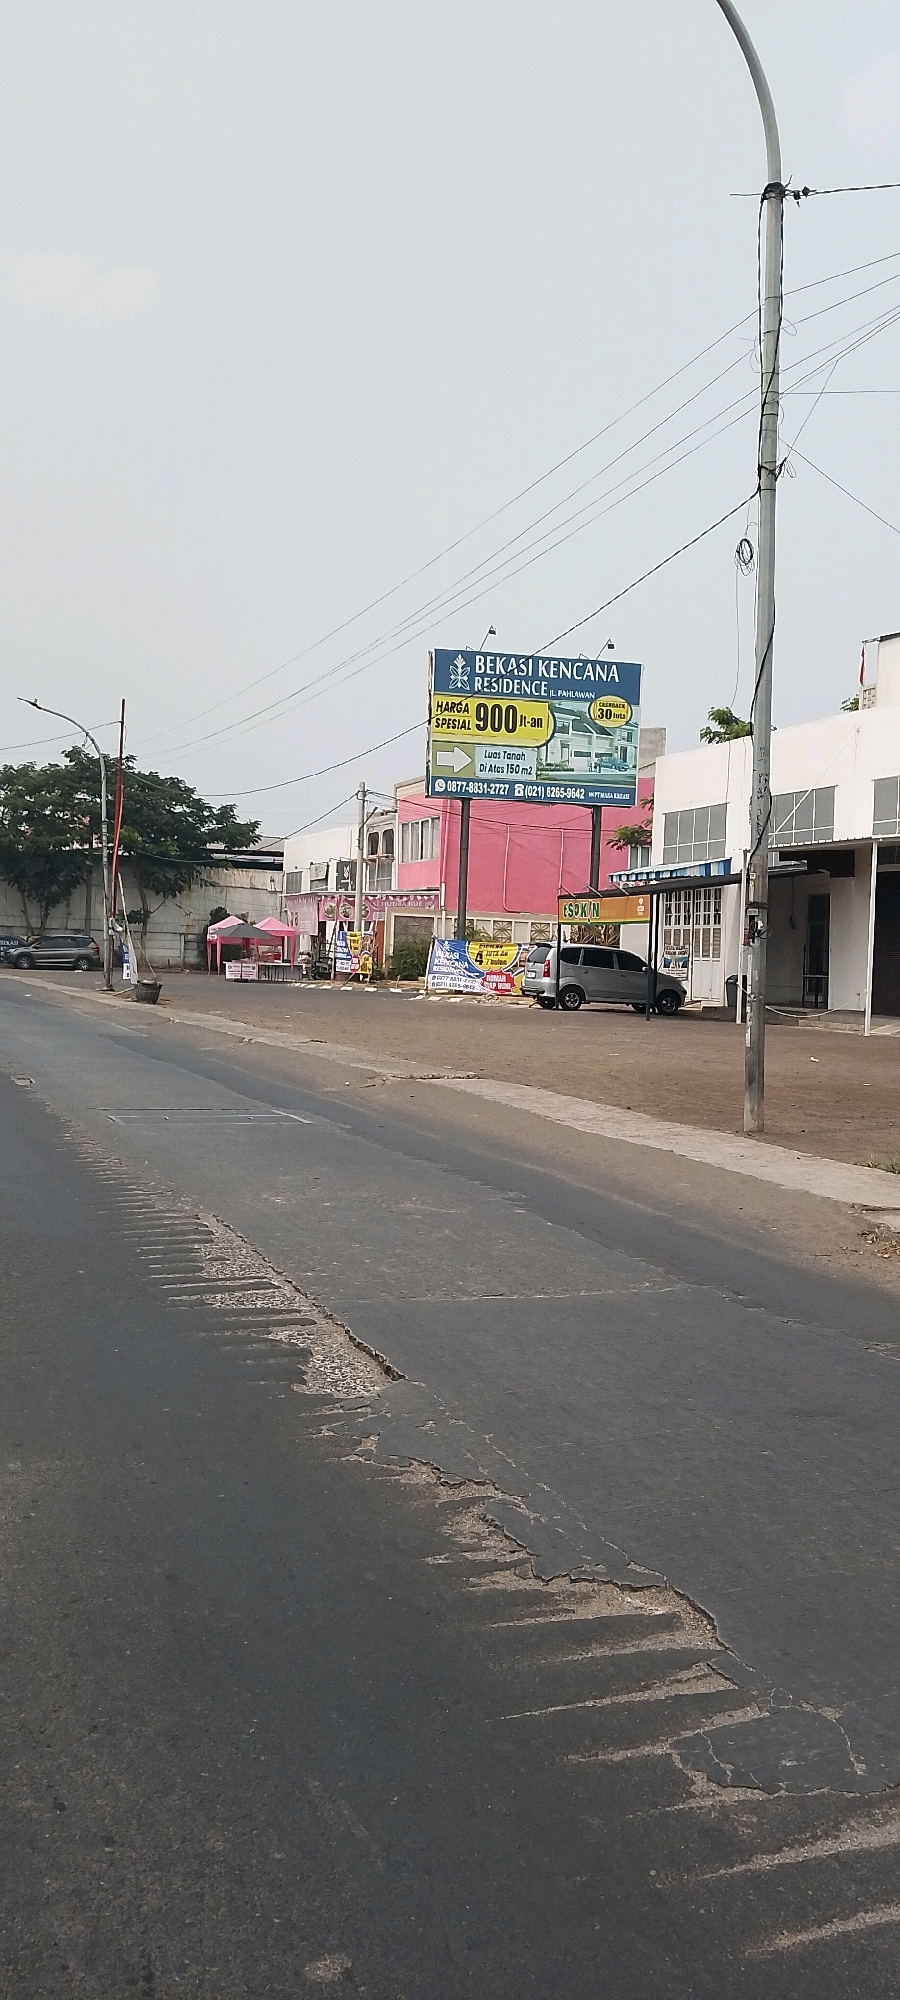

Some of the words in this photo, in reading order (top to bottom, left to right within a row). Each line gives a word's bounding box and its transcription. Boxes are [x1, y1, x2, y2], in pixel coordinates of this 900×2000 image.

[475, 655, 532, 676] BEKASI
[539, 658, 620, 683] KENCANA
[475, 676, 548, 696] RESIDENCE
[558, 690, 595, 699] PAHLAWAN
[436, 700, 470, 714] HARGA
[598, 708, 613, 719] 30
[435, 717, 471, 730] SPESIAL
[475, 702, 518, 733] 900
[484, 749, 501, 759] Luas
[503, 751, 526, 761] Tanah
[479, 764, 487, 773] Di
[487, 765, 504, 774] Atas
[506, 764, 520, 775] 150
[521, 766, 533, 776] m2
[447, 781, 509, 796] 0877-8831-2727
[525, 785, 545, 799] (021)
[475, 950, 484, 966] 4
